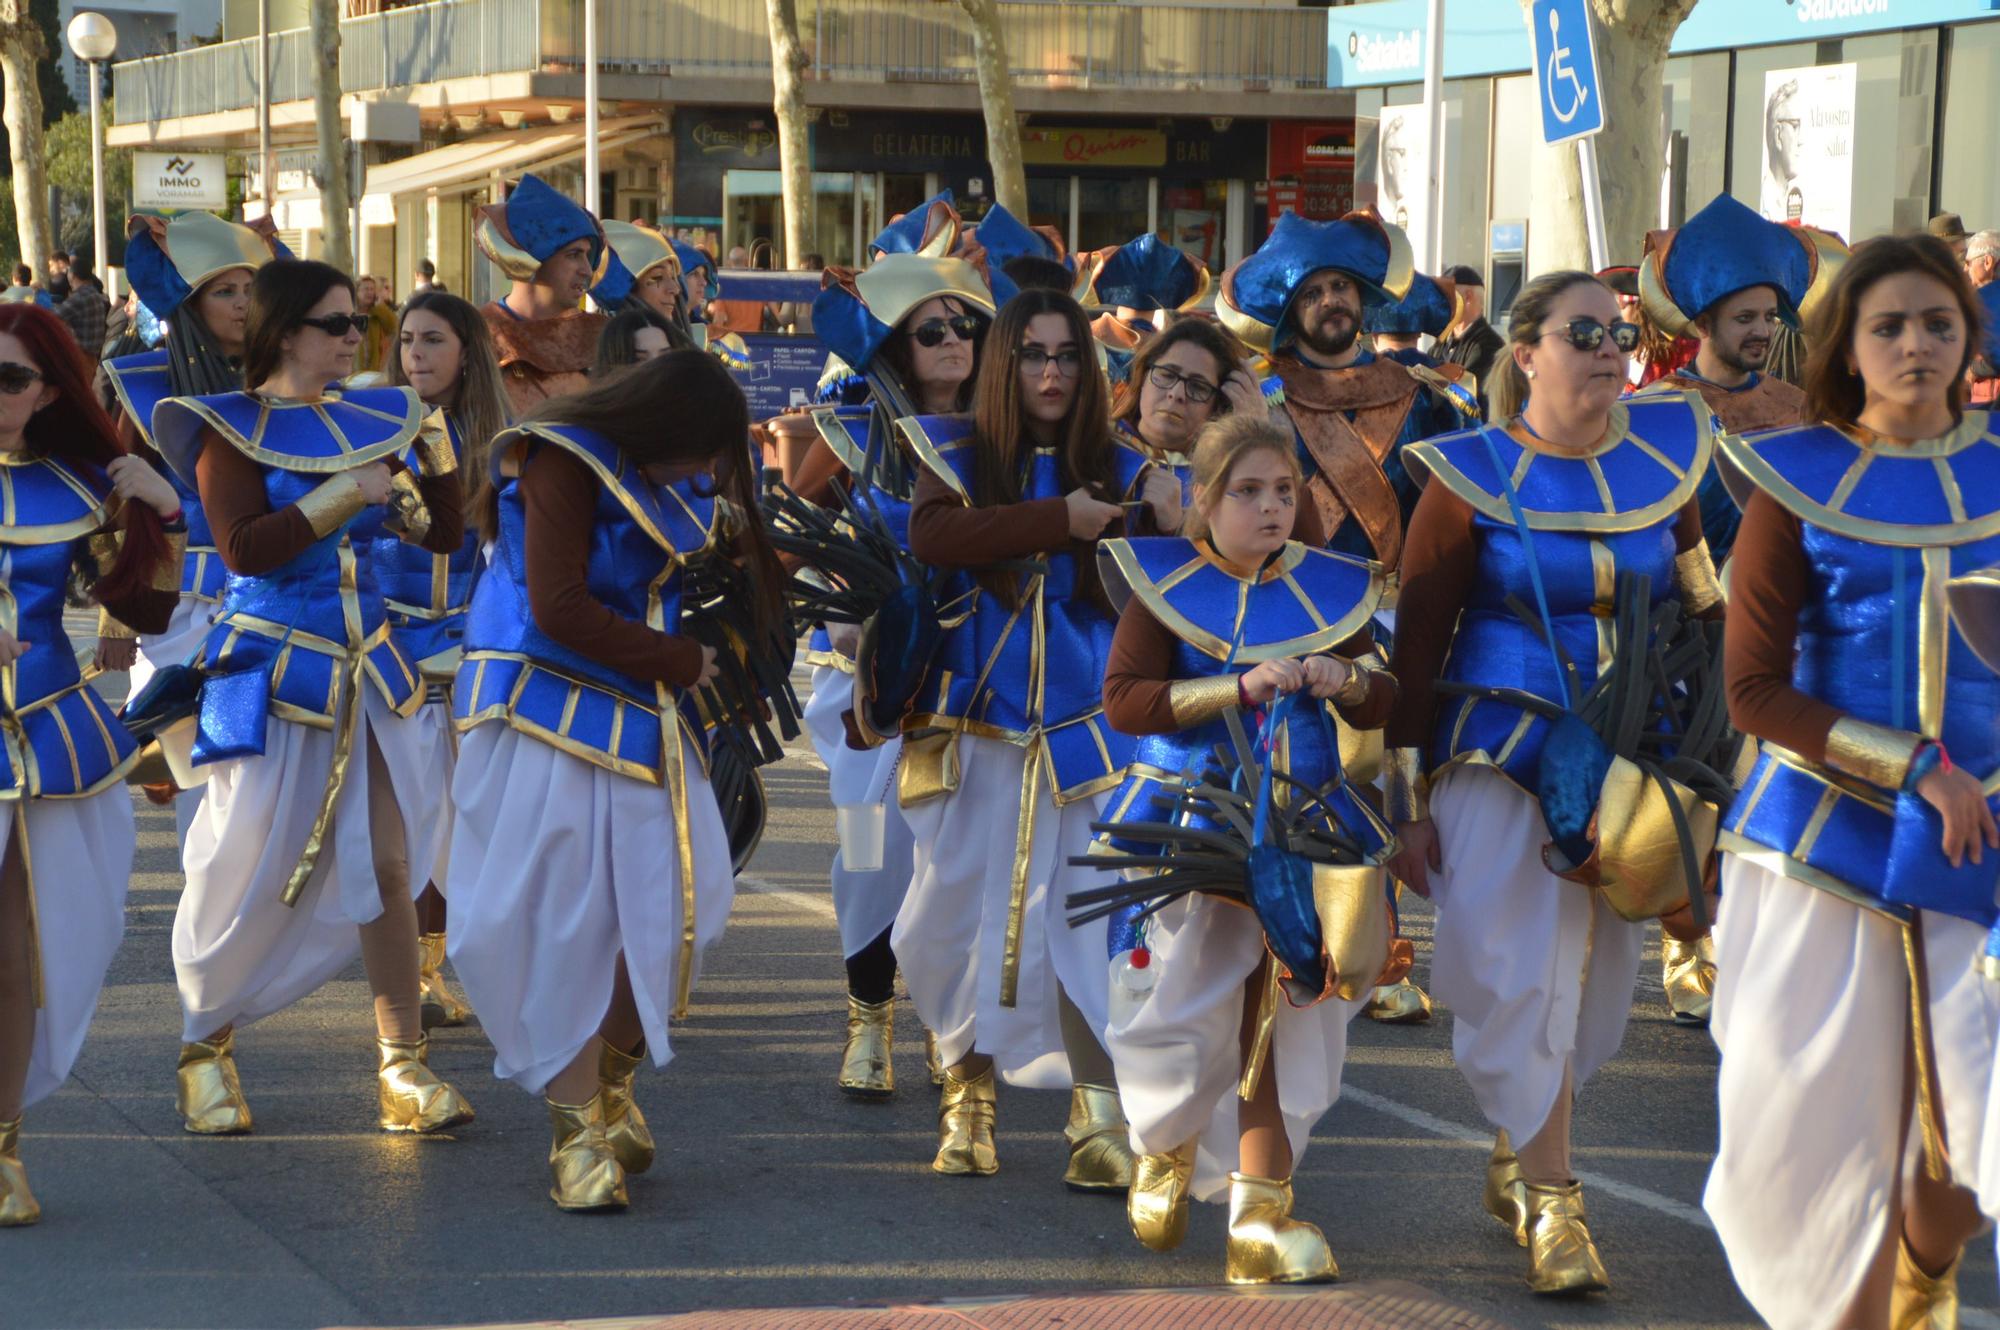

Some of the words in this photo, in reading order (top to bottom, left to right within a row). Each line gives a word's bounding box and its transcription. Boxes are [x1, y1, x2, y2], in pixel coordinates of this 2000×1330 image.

[1355, 30, 1420, 73] Sabadell
[872, 133, 972, 157] GELATERIA
[1176, 140, 1210, 162] BAR
[159, 177, 201, 188] IMMO
